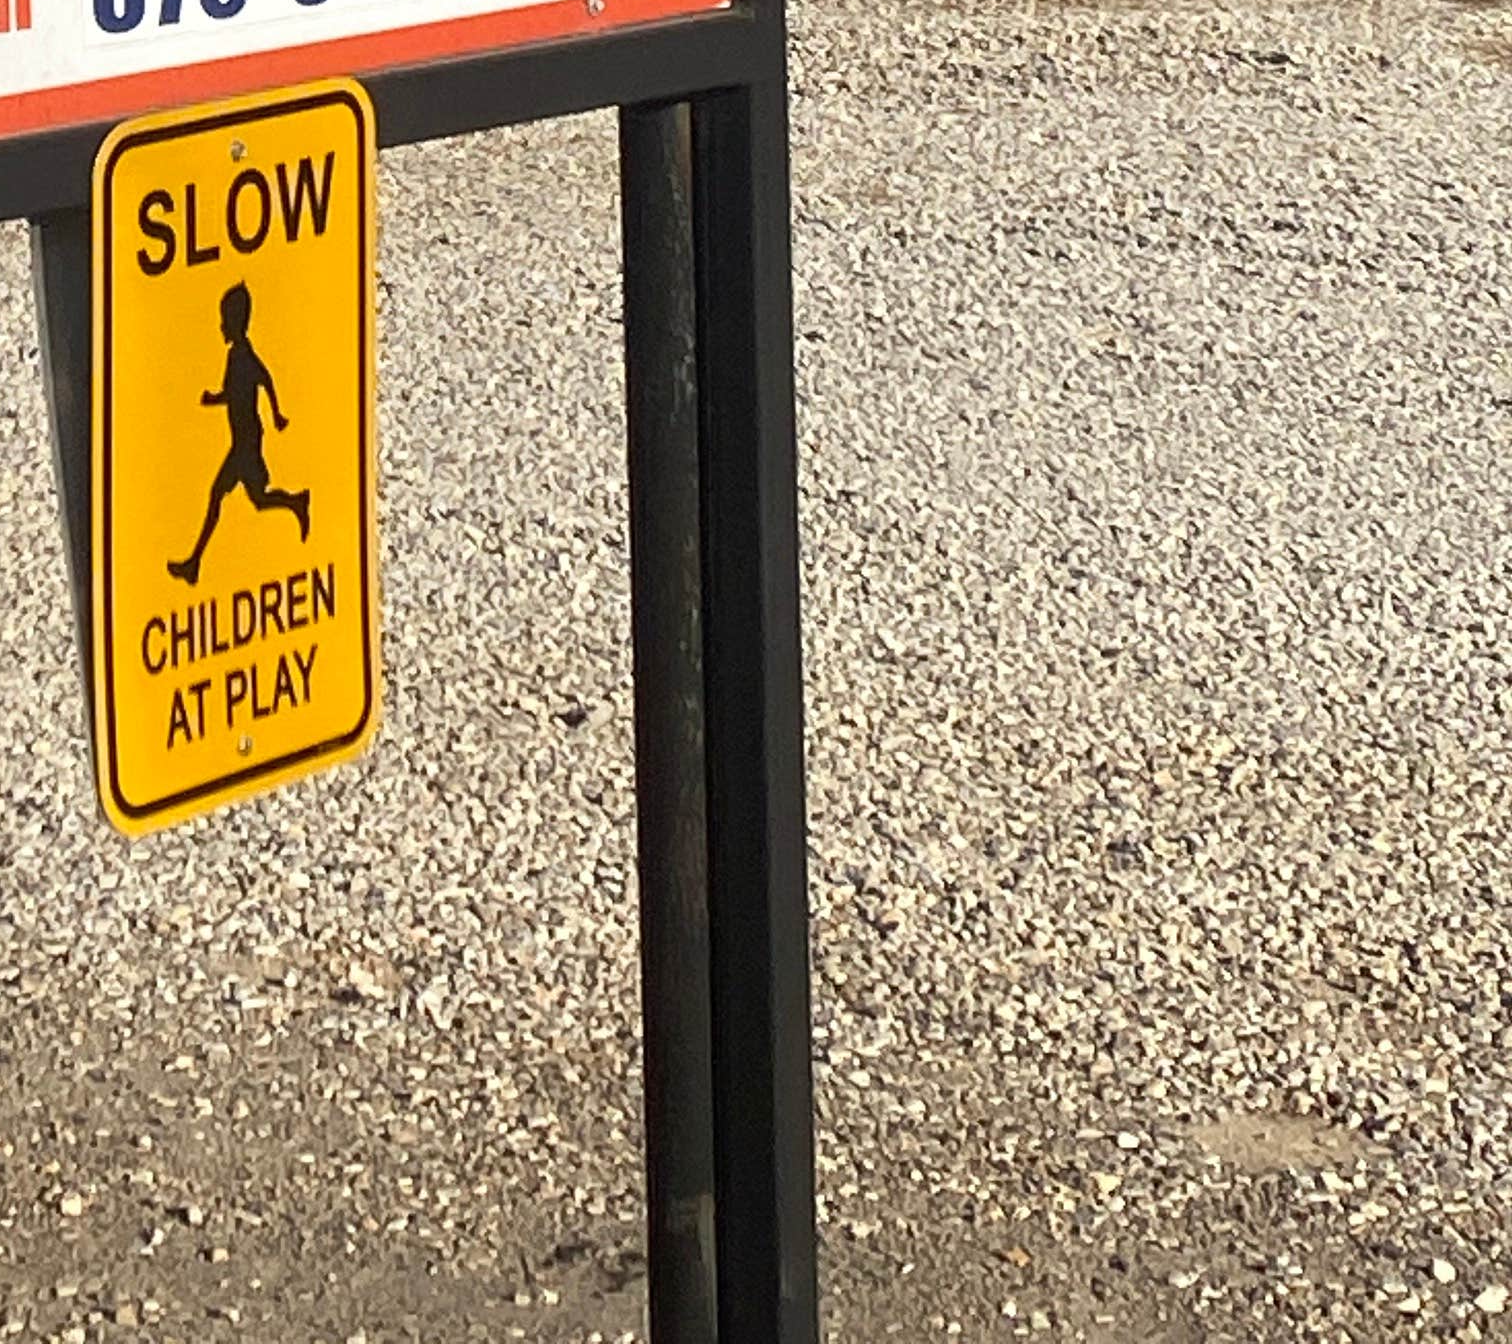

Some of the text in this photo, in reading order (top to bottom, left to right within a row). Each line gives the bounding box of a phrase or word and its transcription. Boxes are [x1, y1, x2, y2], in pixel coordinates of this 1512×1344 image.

[136, 151, 335, 276] SLOW
[141, 564, 336, 675] CHILDREN
[166, 644, 318, 750] AT PLAY
